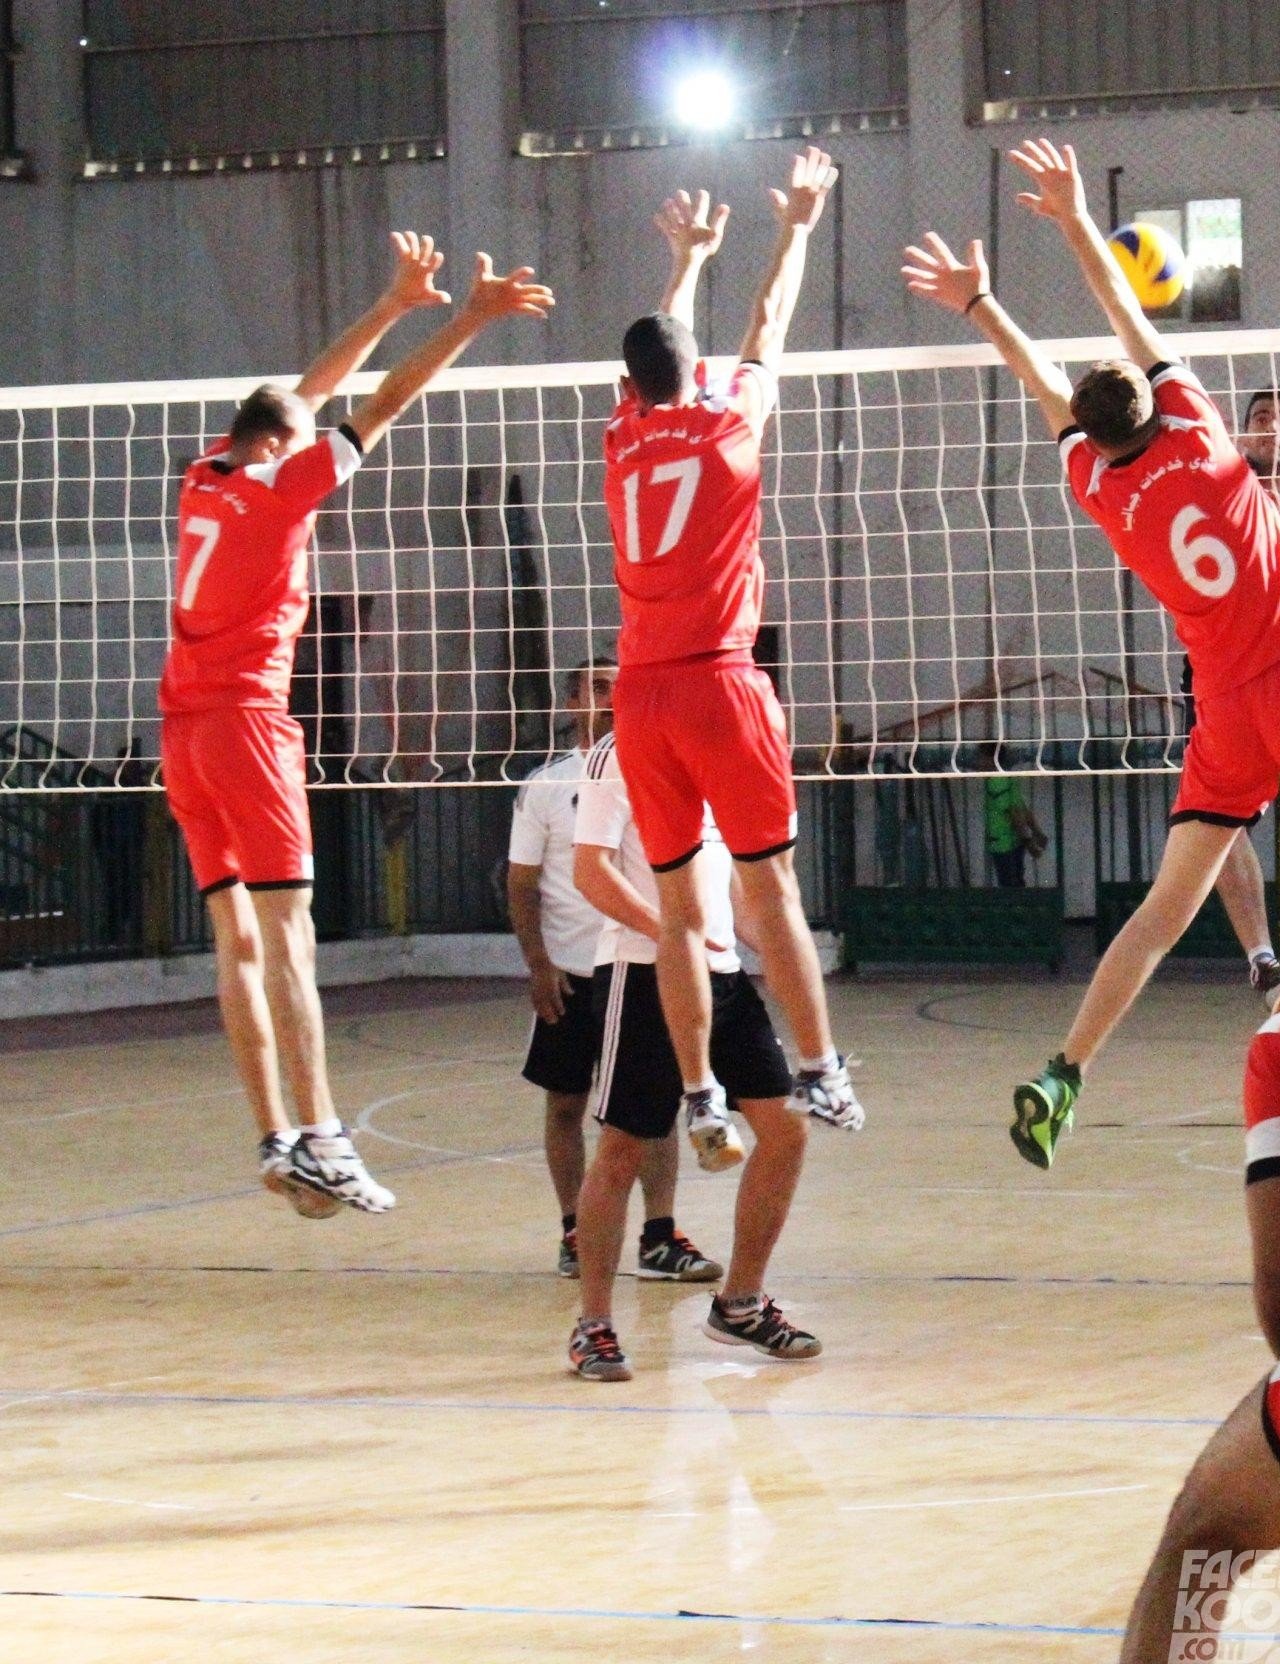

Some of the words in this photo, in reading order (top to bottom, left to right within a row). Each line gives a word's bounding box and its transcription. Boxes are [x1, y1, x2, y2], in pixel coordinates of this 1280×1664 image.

[622, 455, 703, 564] 17
[1168, 504, 1237, 600] 6
[179, 516, 222, 611] 7
